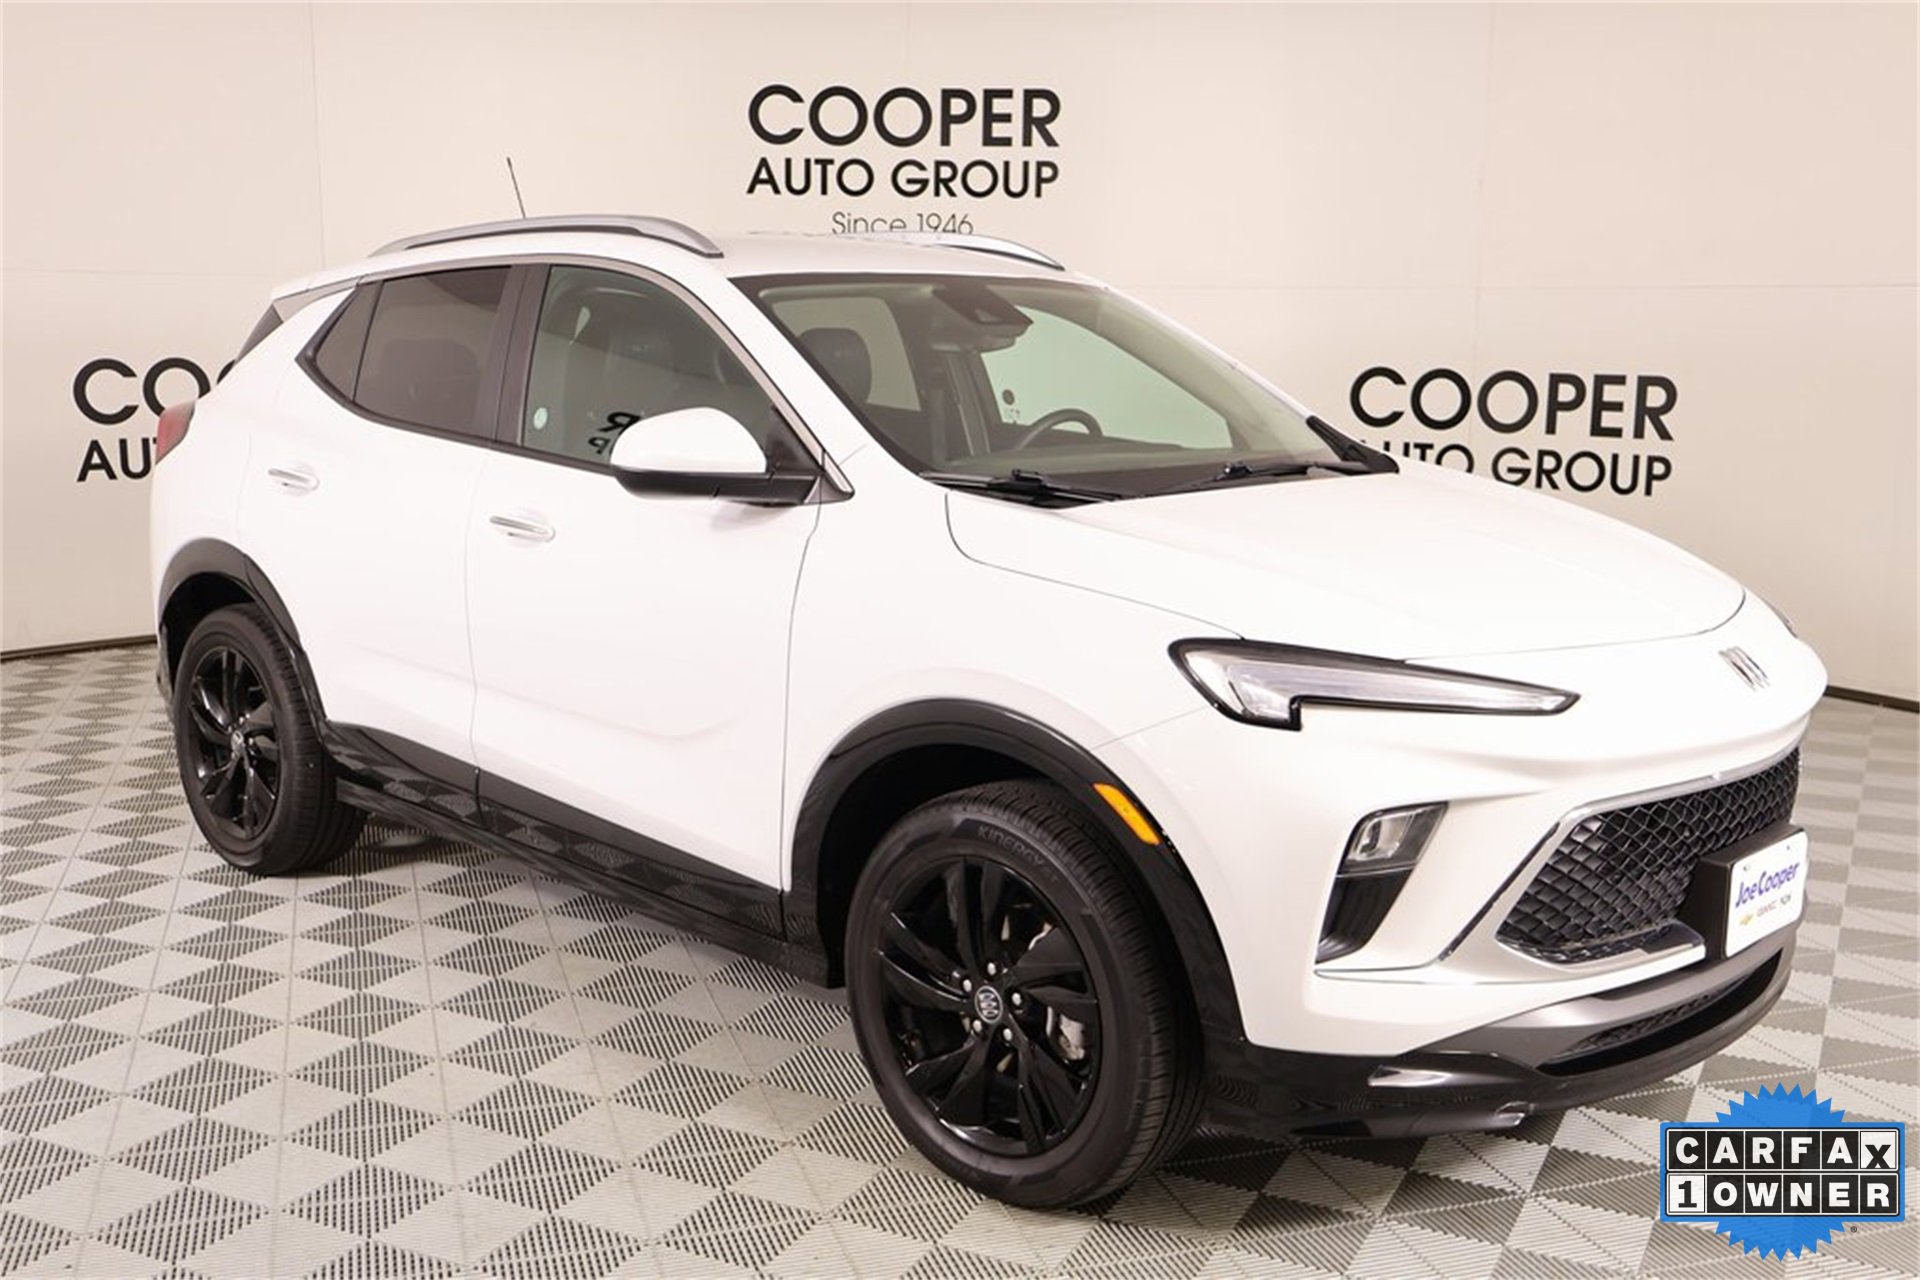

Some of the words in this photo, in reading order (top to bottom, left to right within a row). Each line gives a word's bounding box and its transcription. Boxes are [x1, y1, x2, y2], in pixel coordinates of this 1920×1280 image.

[748, 84, 1061, 148] COOPER
[746, 156, 875, 197] AUTO
[891, 159, 1059, 199] GROUP
[831, 211, 907, 236] Since
[917, 212, 974, 236] 1946
[73, 357, 236, 425] CO
[1350, 366, 1678, 441] COOPER
[76, 437, 157, 483] AU
[1491, 446, 1673, 497] GROUP
